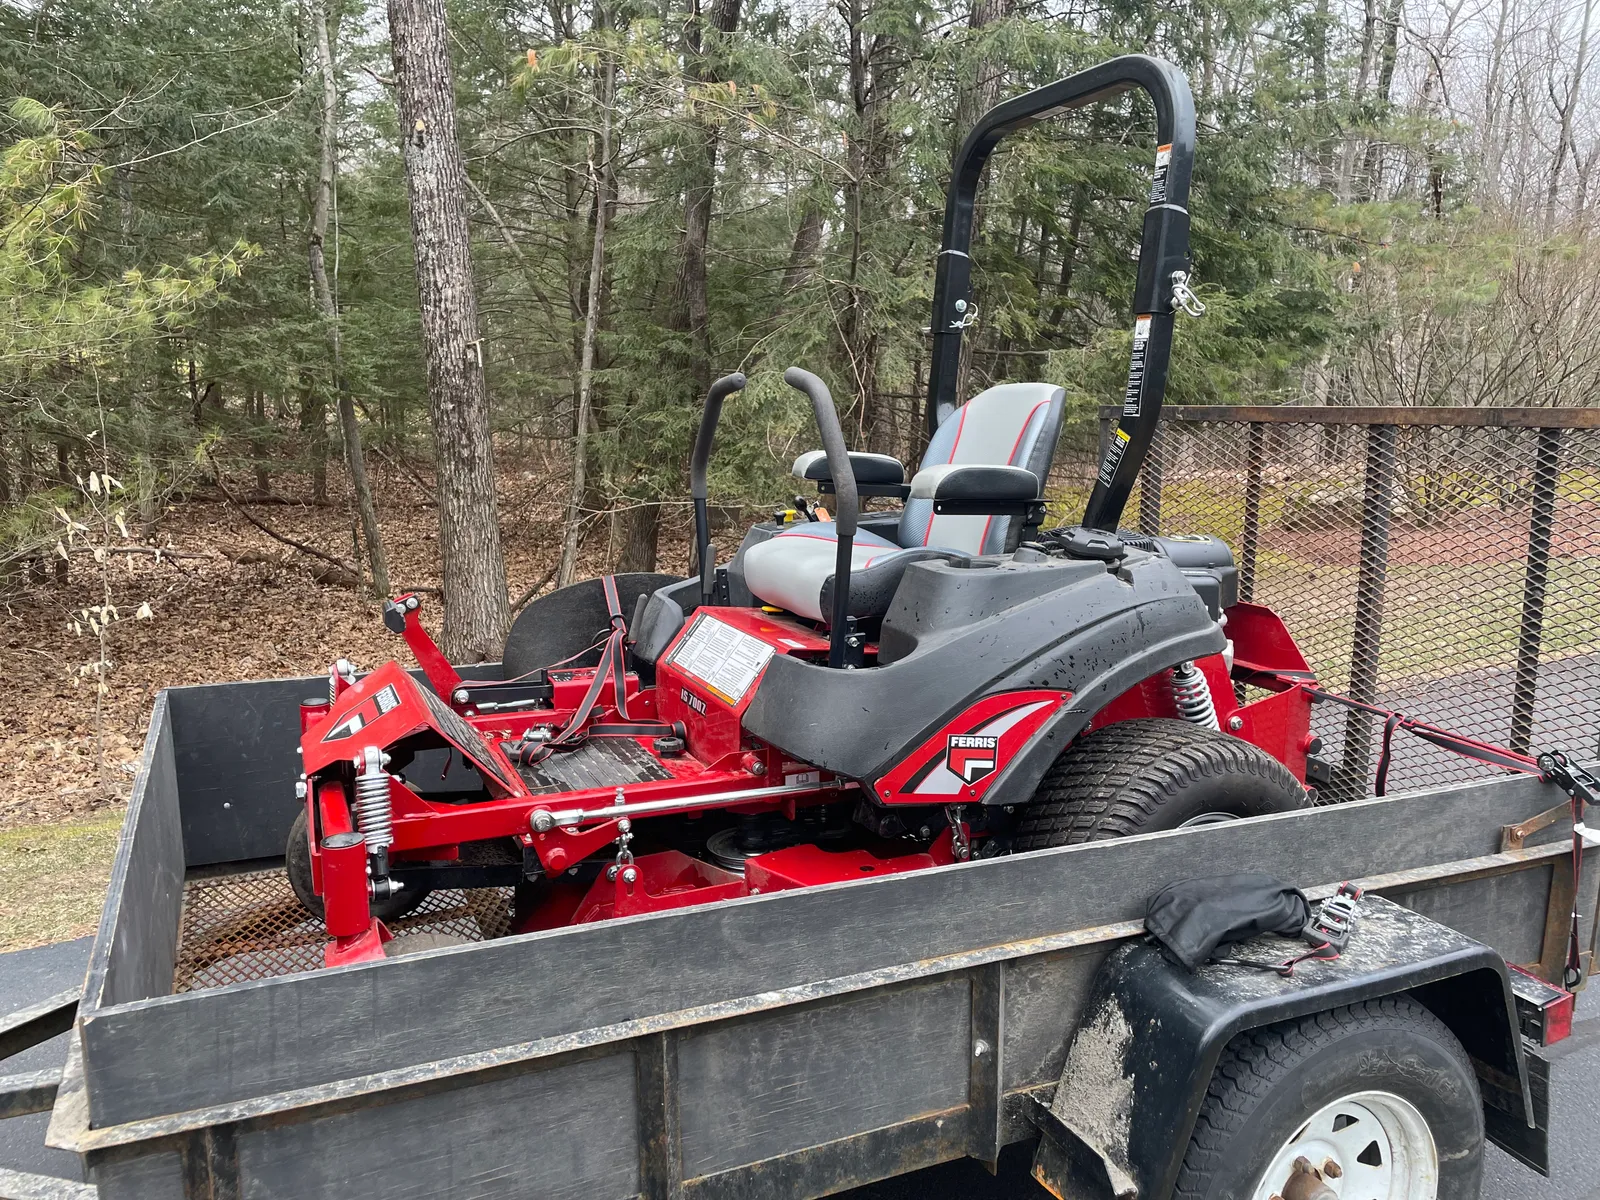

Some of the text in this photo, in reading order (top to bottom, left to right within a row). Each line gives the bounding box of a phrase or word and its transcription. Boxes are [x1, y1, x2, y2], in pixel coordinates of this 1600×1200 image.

[681, 688, 688, 702] IS
[688, 693, 706, 715] 700Z
[951, 736, 996, 748] FERRIS
